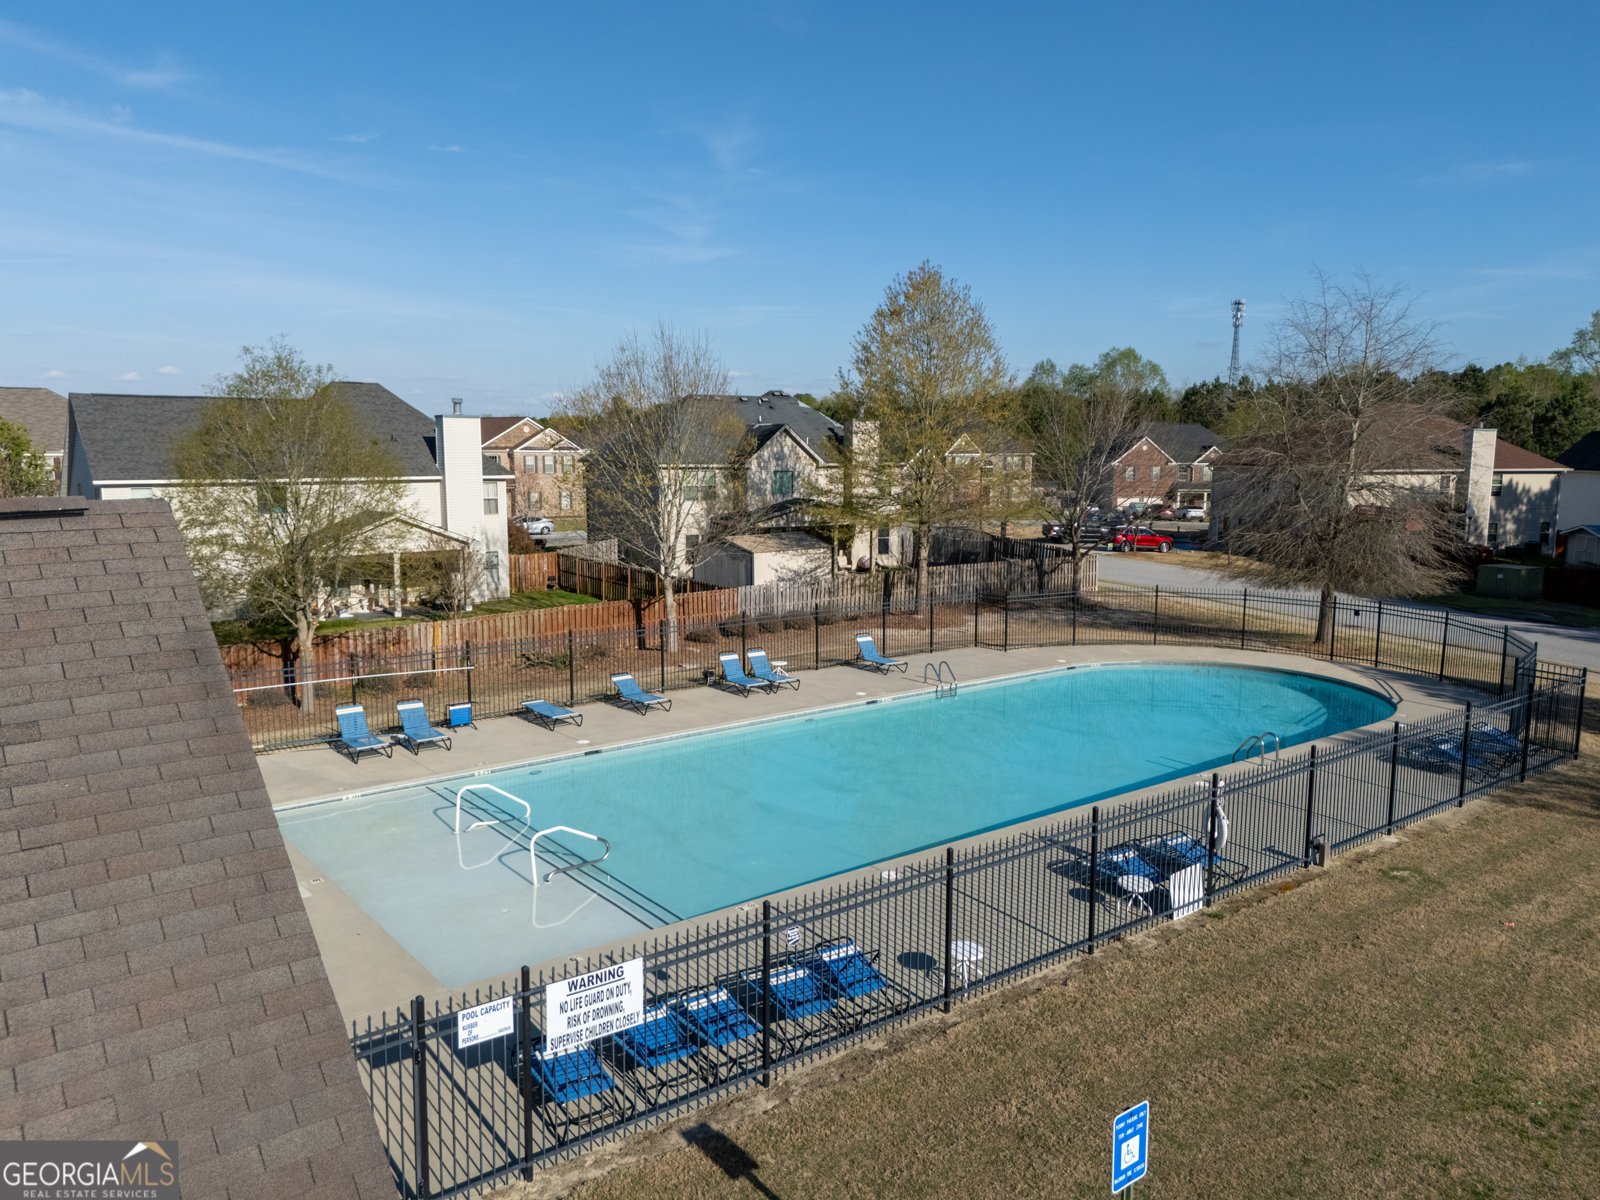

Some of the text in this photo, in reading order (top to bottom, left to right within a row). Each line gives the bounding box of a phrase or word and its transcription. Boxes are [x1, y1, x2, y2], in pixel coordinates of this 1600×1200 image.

[568, 965, 624, 992] WARNING
[461, 1000, 510, 1021] POOL CAPACITY
[560, 981, 632, 1014] NO LIFE GUARD ON DUTY,
[462, 1021, 478, 1031] NUMBER
[567, 1000, 625, 1029] RISK OF DROWNING,
[461, 1034, 479, 1044] PERSONS
[550, 1011, 640, 1051] SUPERVISE CHILDREN CLOSELY
